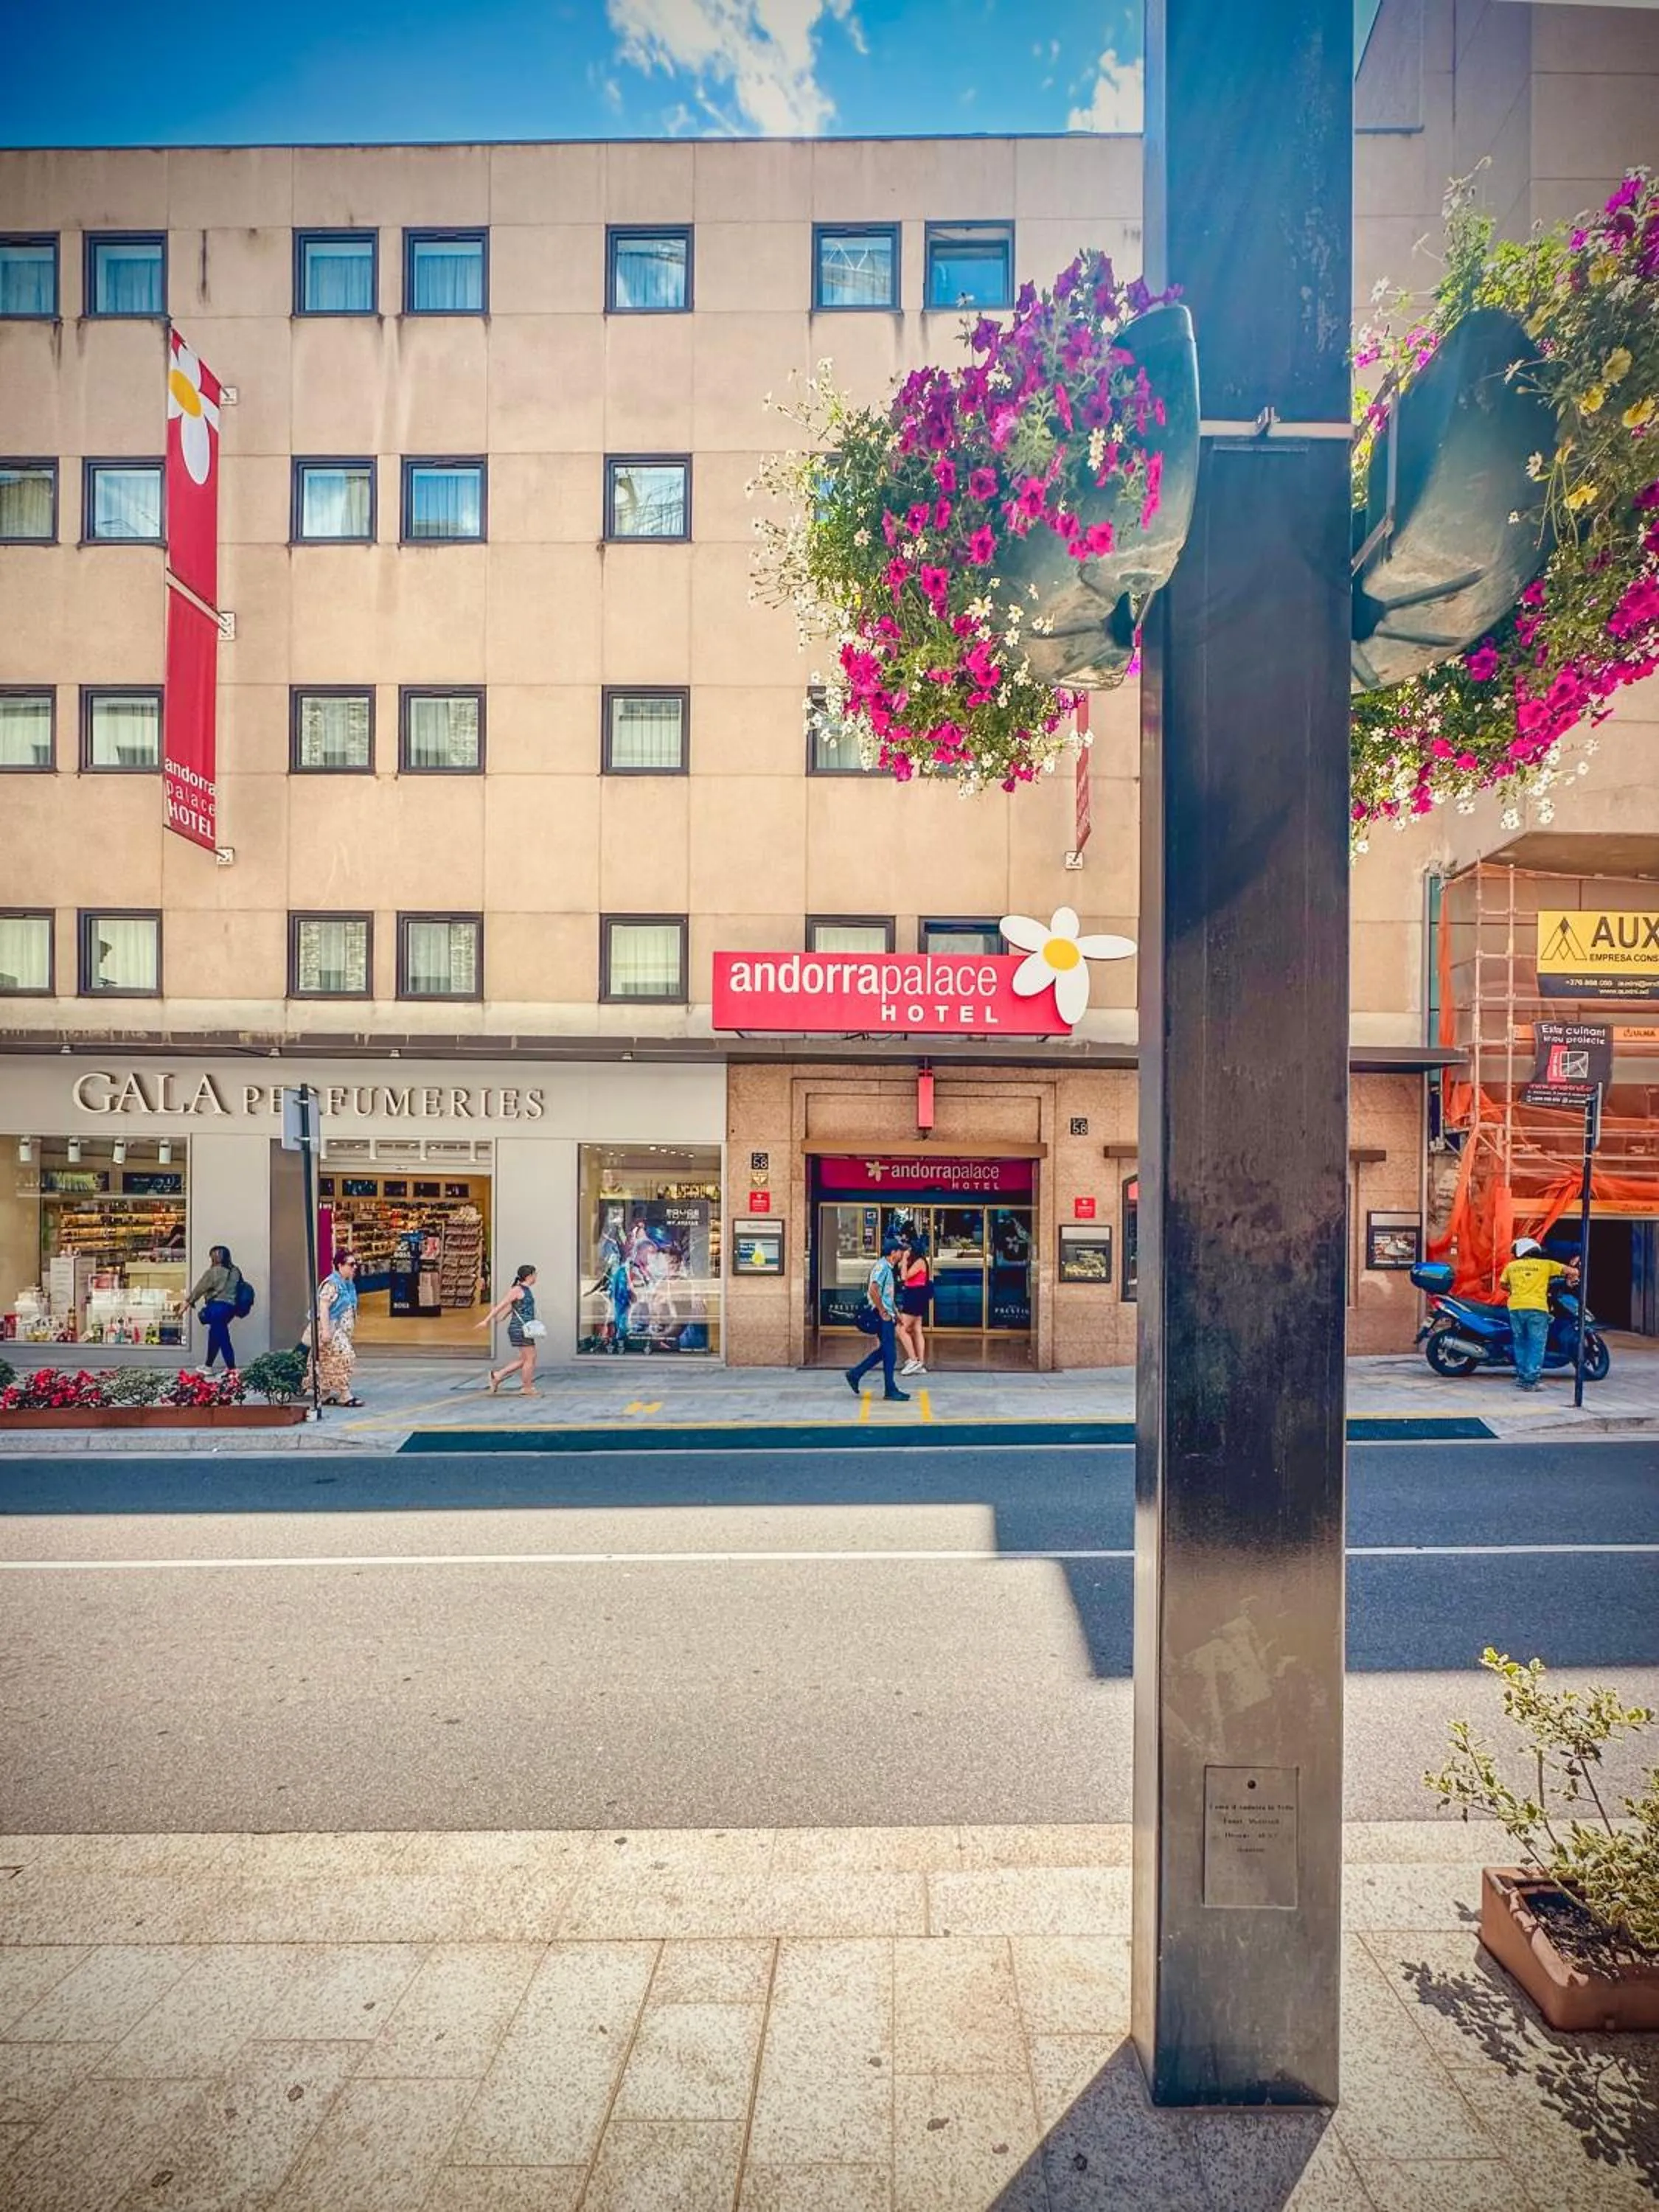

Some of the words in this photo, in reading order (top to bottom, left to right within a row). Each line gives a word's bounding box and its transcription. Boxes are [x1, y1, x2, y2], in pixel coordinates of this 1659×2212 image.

[165, 757, 215, 796] andorra
[166, 780, 215, 816] palace
[168, 798, 215, 840] HOTEL
[1589, 954, 1632, 962] EMPRESA
[730, 956, 997, 1004] andorrapalace
[881, 1005, 998, 1023] HOTEL
[72, 1073, 230, 1114] GALA
[242, 1085, 544, 1119] PEFUMERIES
[753, 1157, 768, 1169] 58
[891, 1162, 1000, 1181] andorrapalace
[952, 1182, 1000, 1190] HOTEL
